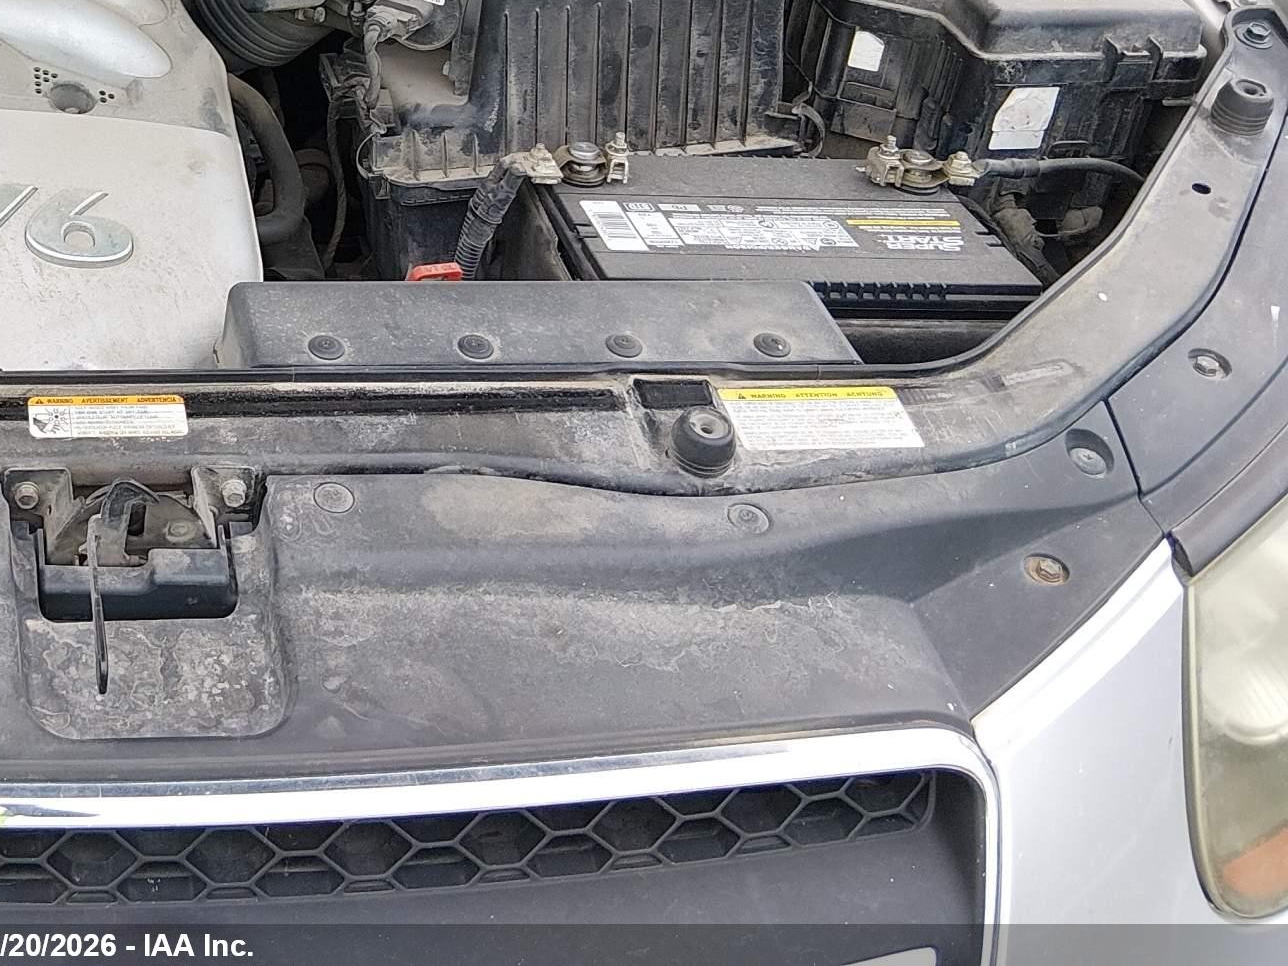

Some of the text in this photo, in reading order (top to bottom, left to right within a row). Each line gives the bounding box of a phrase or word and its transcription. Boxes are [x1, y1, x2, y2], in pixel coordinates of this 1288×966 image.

[886, 234, 965, 246] START
[886, 242, 961, 252] SUPER
[137, 396, 177, 404] ADVERTENCIA
